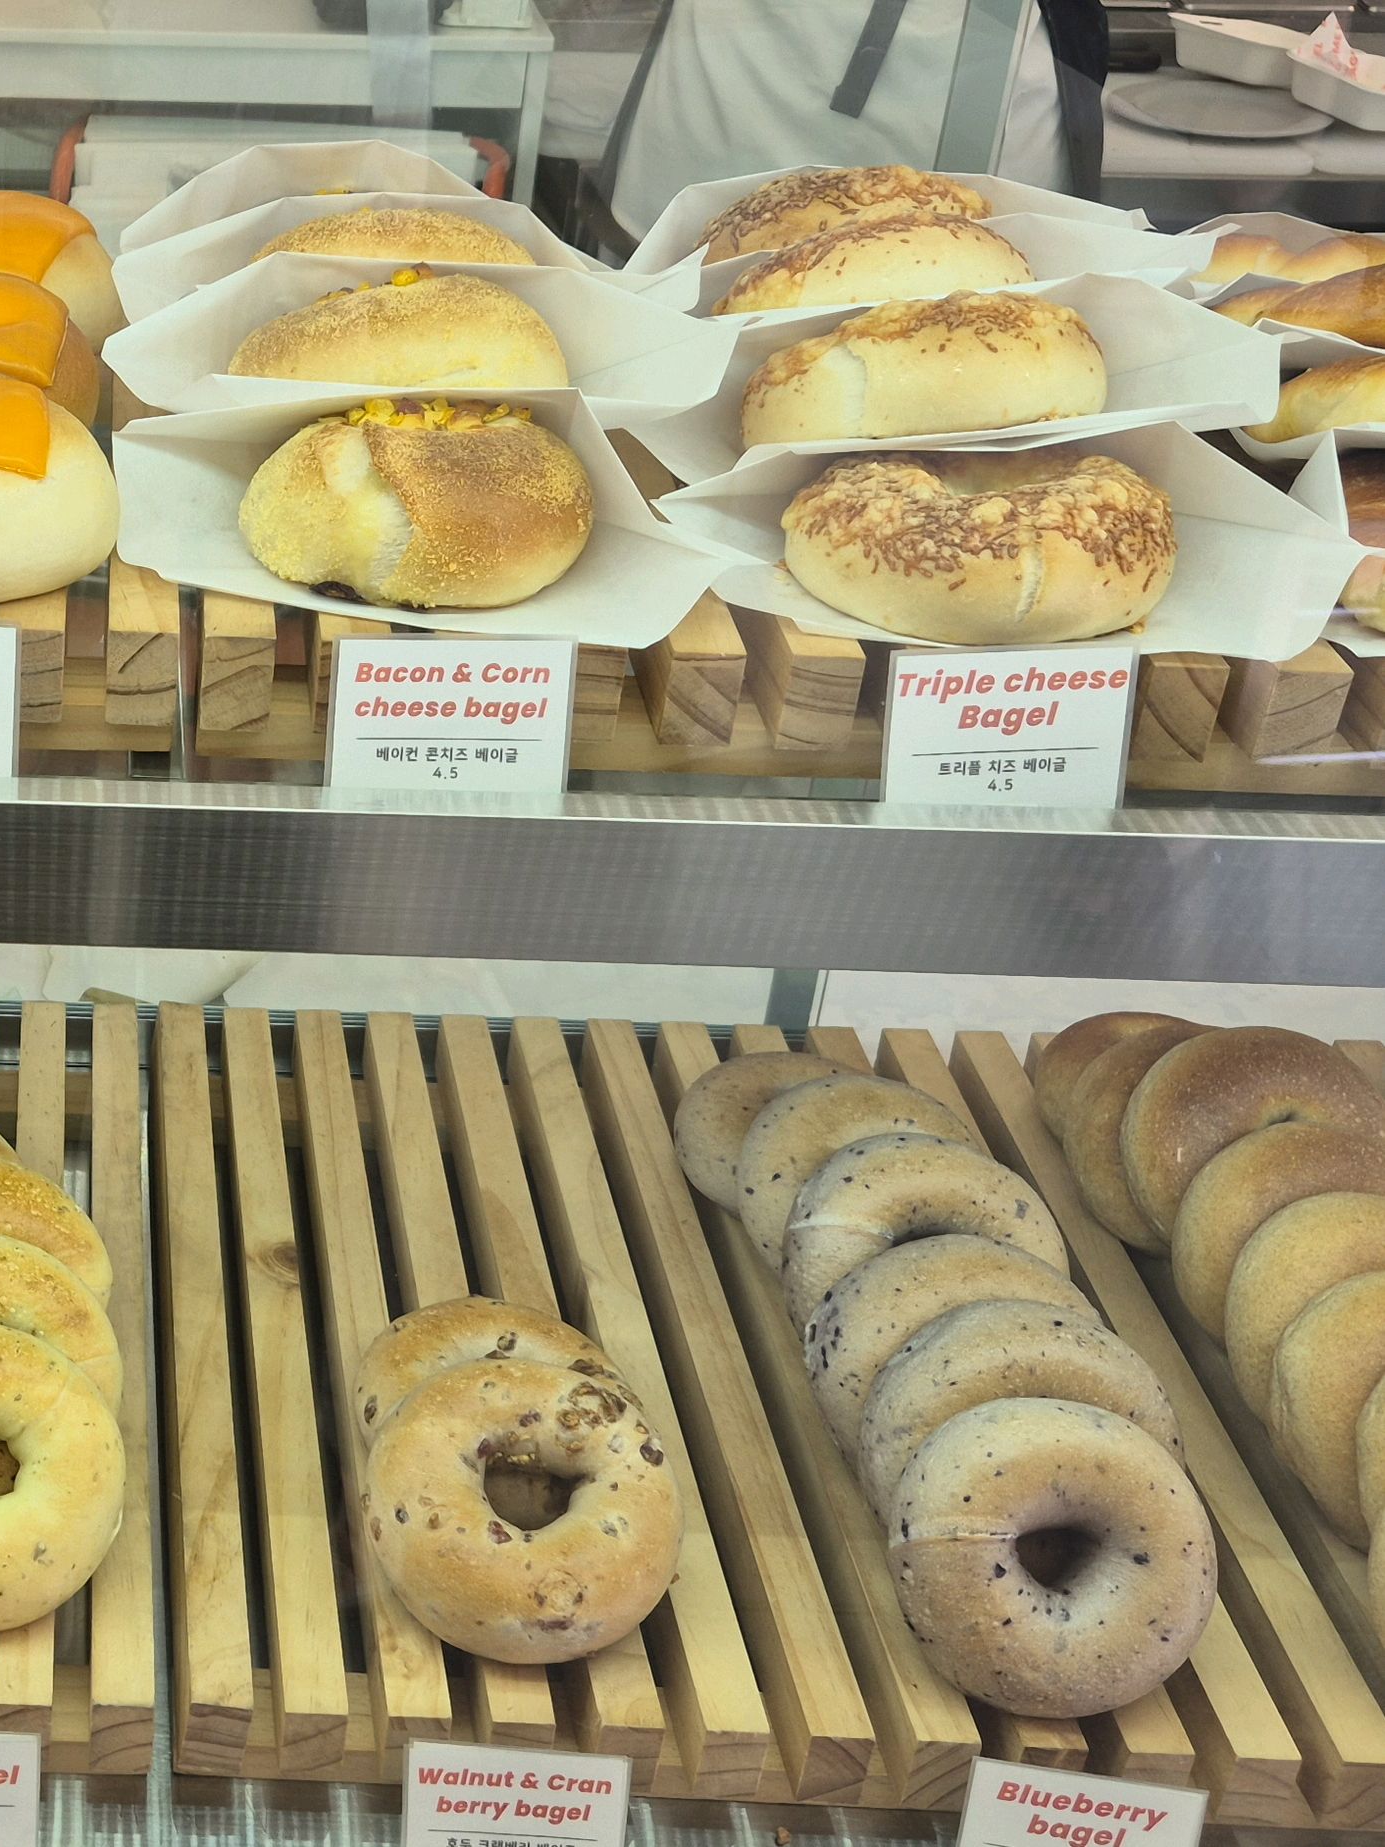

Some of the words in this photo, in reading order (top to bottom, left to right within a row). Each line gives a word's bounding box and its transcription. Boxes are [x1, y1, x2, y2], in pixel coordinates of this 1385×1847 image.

[356, 663, 445, 683] Bacon
[453, 664, 471, 683] &
[482, 664, 550, 684] Corn
[898, 670, 996, 705] Triple
[1005, 668, 1129, 693] cheese
[355, 697, 458, 718] cheese
[465, 698, 548, 725] bagel
[959, 702, 1059, 735] Bagel
[377, 747, 418, 761] 베이컨
[426, 747, 467, 762] 콘치즈
[476, 748, 518, 763] 베이글
[938, 760, 981, 775] 트리플
[989, 760, 1015, 774] 치즈
[1023, 757, 1066, 772] 베이글
[433, 767, 457, 779] 4.5
[988, 779, 1012, 791] 4.5
[419, 1769, 514, 1788] Walnut
[522, 1773, 538, 1789] &
[548, 1775, 612, 1794] Cran
[438, 1798, 510, 1820] berry
[514, 1800, 592, 1825] bagel
[998, 1782, 1168, 1832] Blueberry
[1027, 1814, 1127, 1847] bagel
